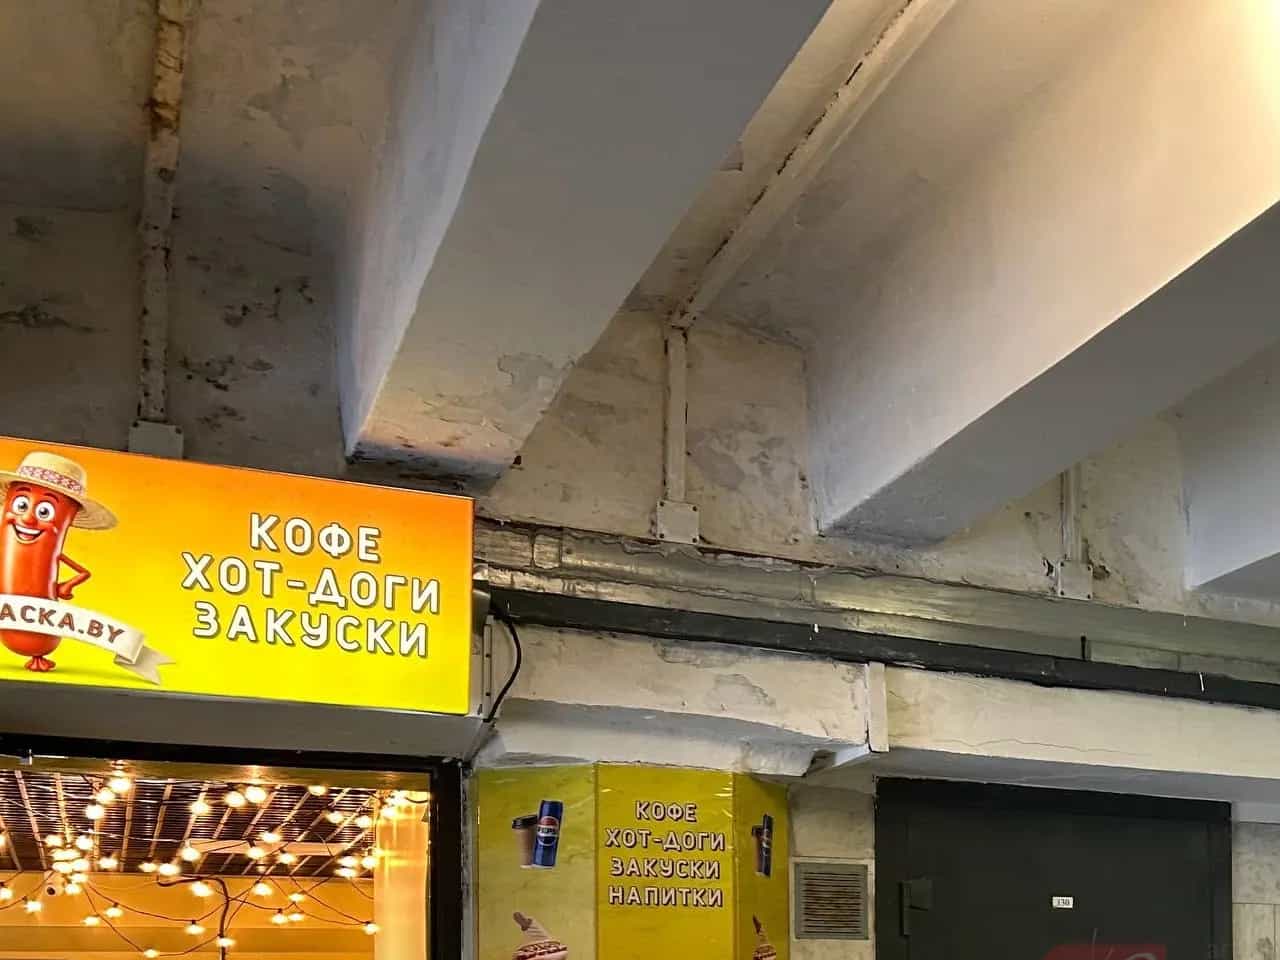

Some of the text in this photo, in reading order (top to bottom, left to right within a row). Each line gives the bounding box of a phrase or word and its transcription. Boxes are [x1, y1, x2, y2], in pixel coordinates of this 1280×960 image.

[249, 513, 381, 562] КОФЕ
[182, 552, 441, 614] ХОТ-ДОГИ
[193, 601, 429, 657] ЗАКУСКИ
[635, 800, 697, 822] КОФЕ
[605, 827, 725, 851] ХОТ-ДОГИ
[610, 856, 720, 879] ЗАКУСКИ
[608, 885, 723, 907] НАПИТКИ
